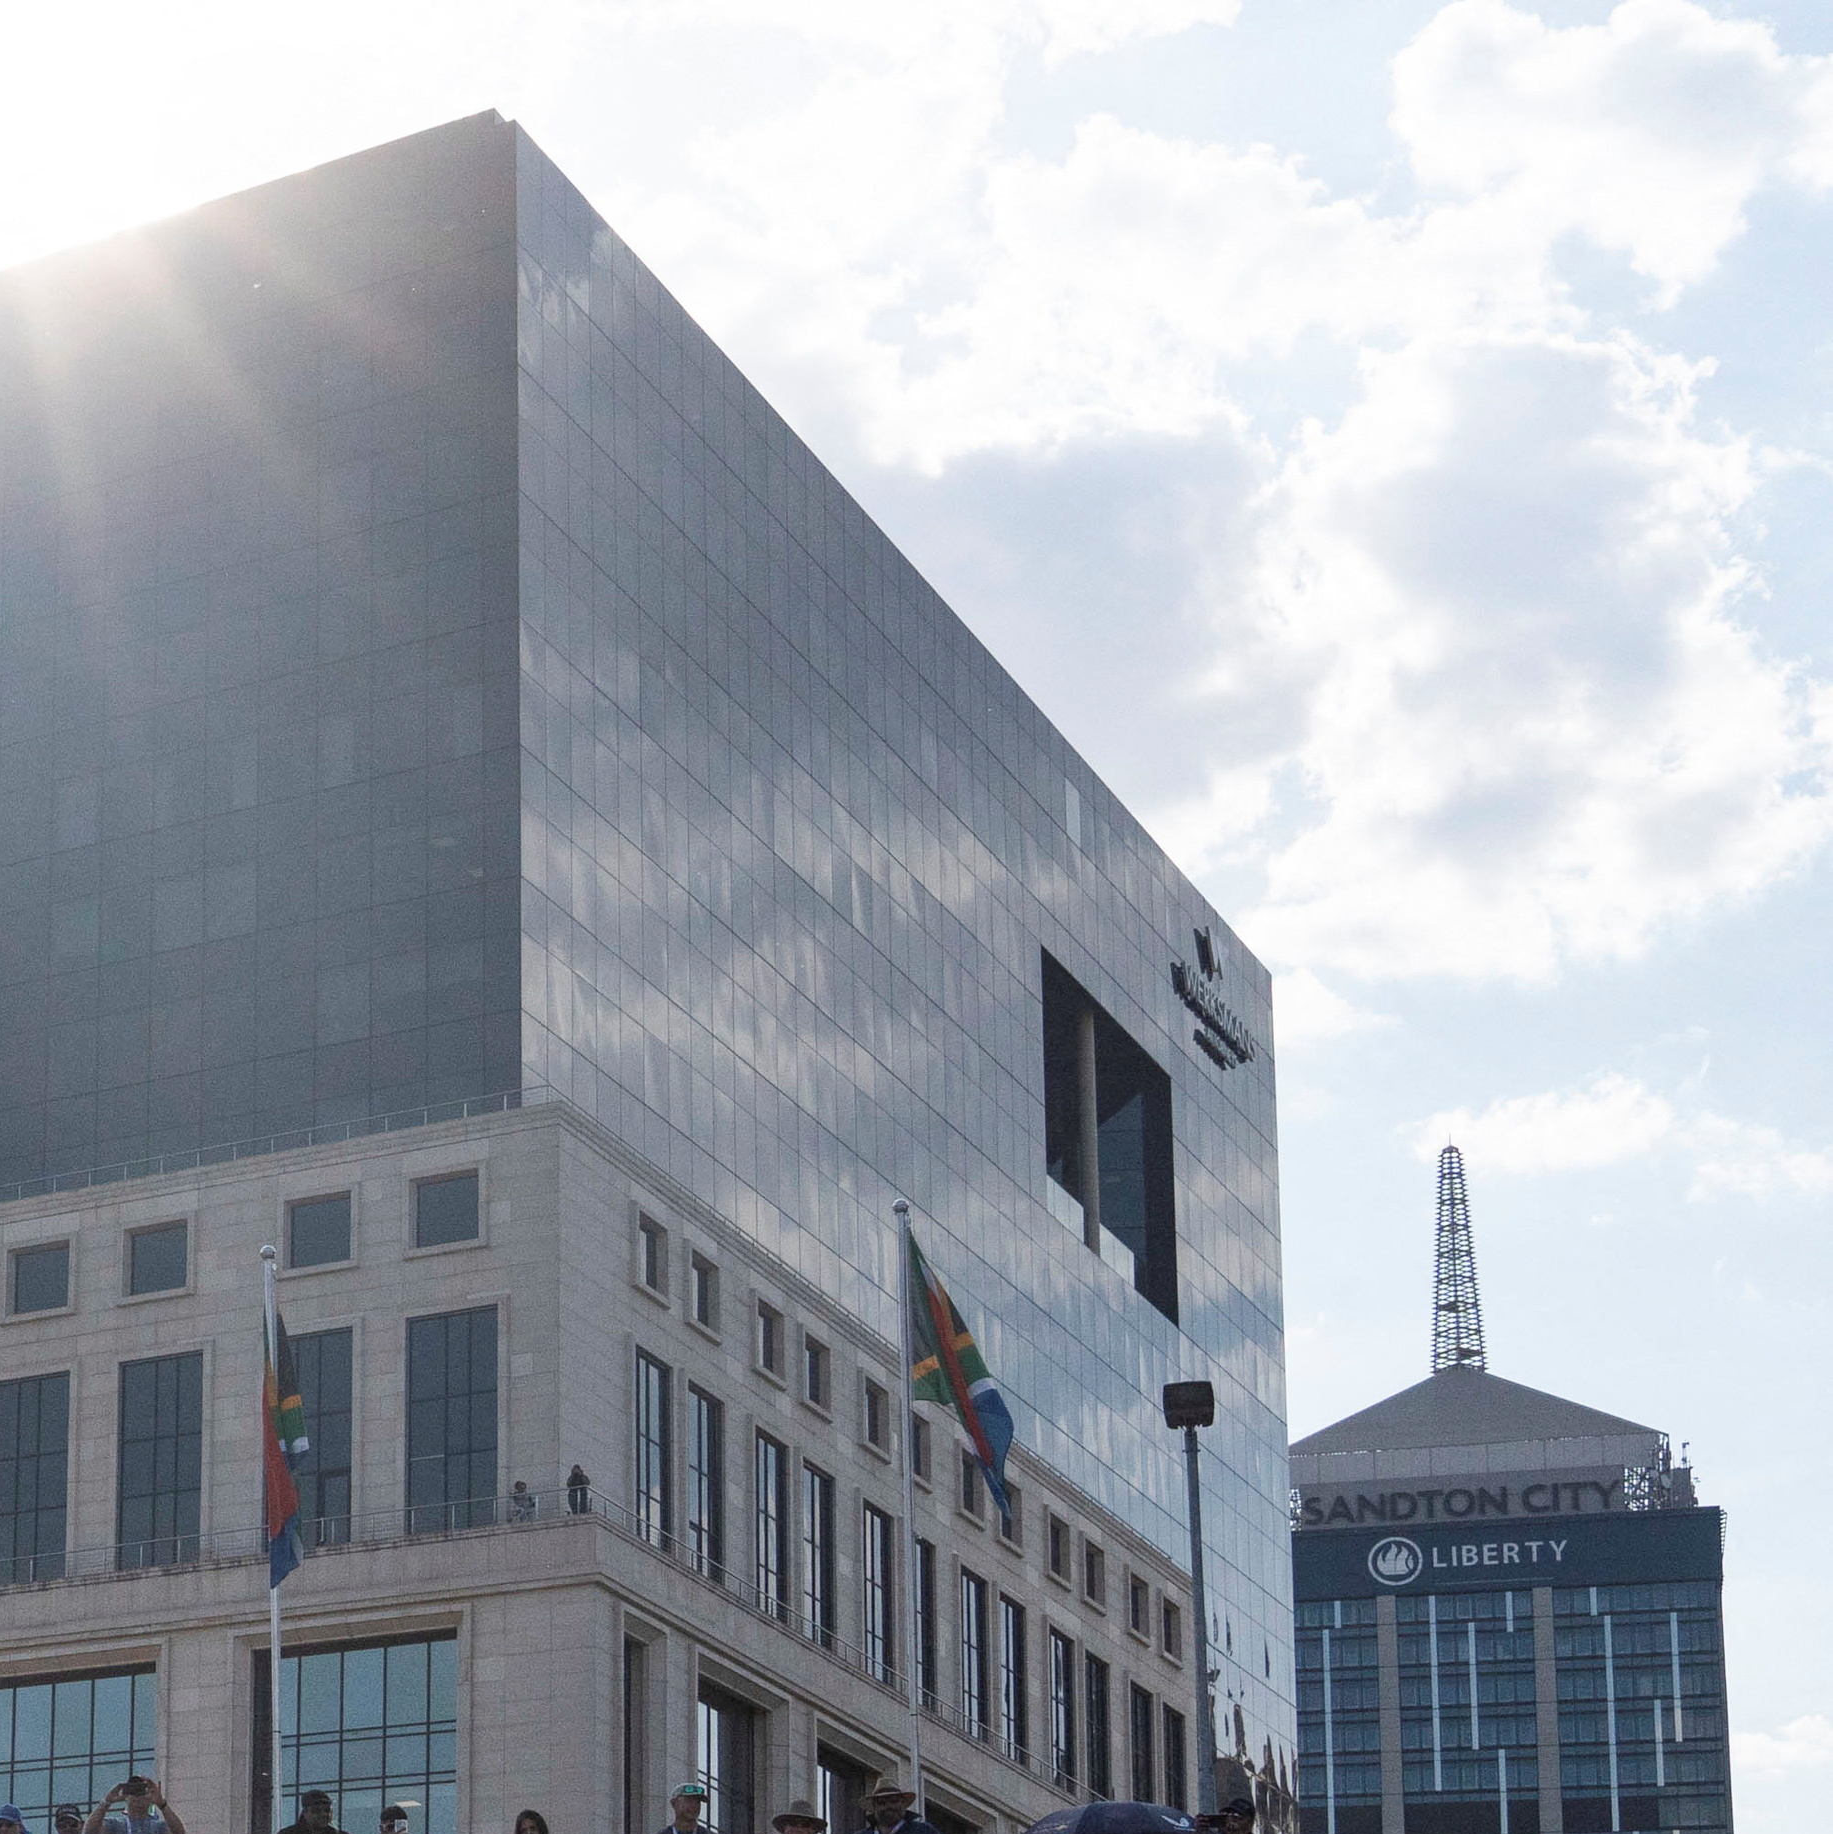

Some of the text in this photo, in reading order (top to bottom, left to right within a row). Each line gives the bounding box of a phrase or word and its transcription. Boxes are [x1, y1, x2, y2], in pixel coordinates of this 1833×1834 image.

[1303, 1481, 1620, 1525] SANDTON CITY
[1432, 1540, 1567, 1568] LIBERTY
